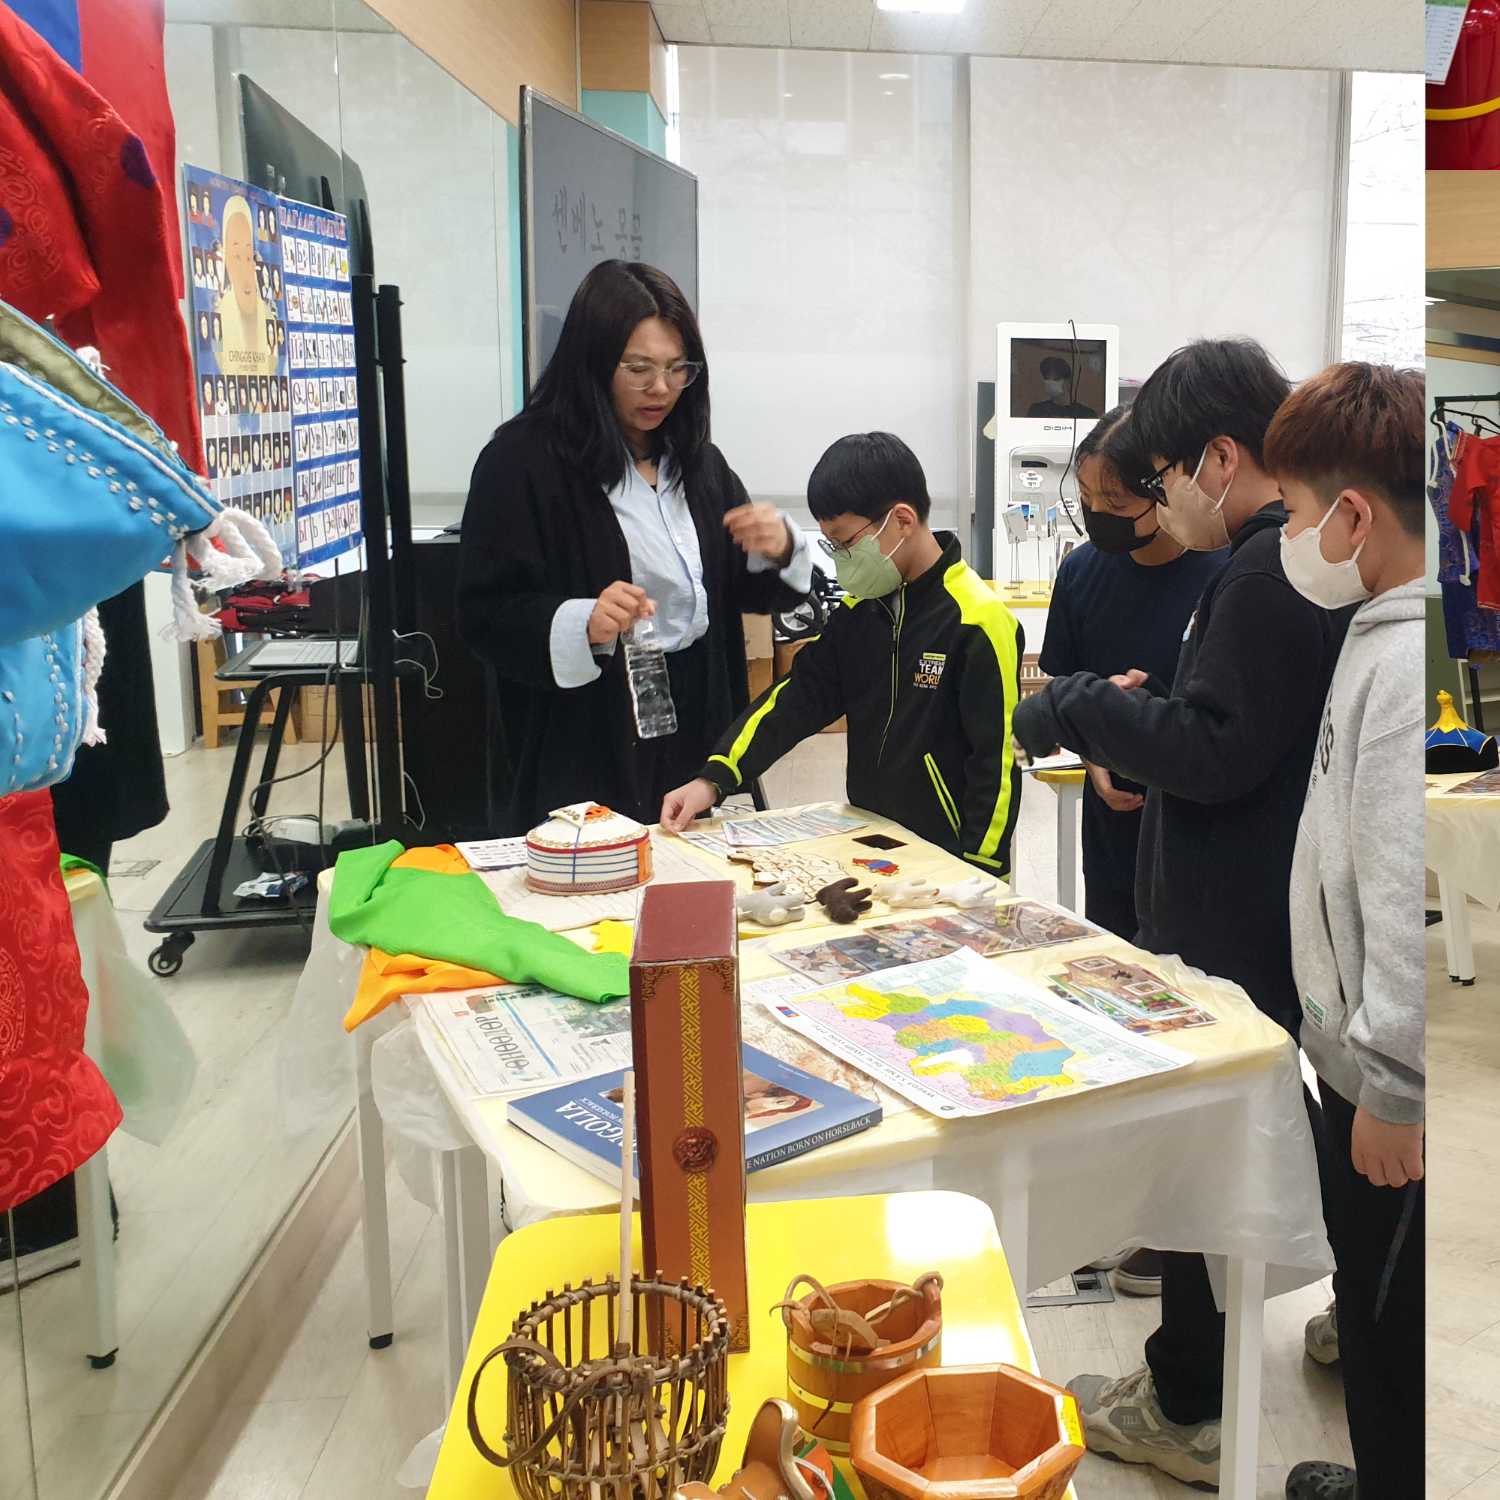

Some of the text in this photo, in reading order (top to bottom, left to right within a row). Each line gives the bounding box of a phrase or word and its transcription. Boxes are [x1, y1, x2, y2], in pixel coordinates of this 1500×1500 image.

[753, 1147, 786, 1166] NATION
[787, 1137, 811, 1154] BORN
[811, 1132, 824, 1144] ON
[825, 1115, 871, 1140] HORSEBACK
